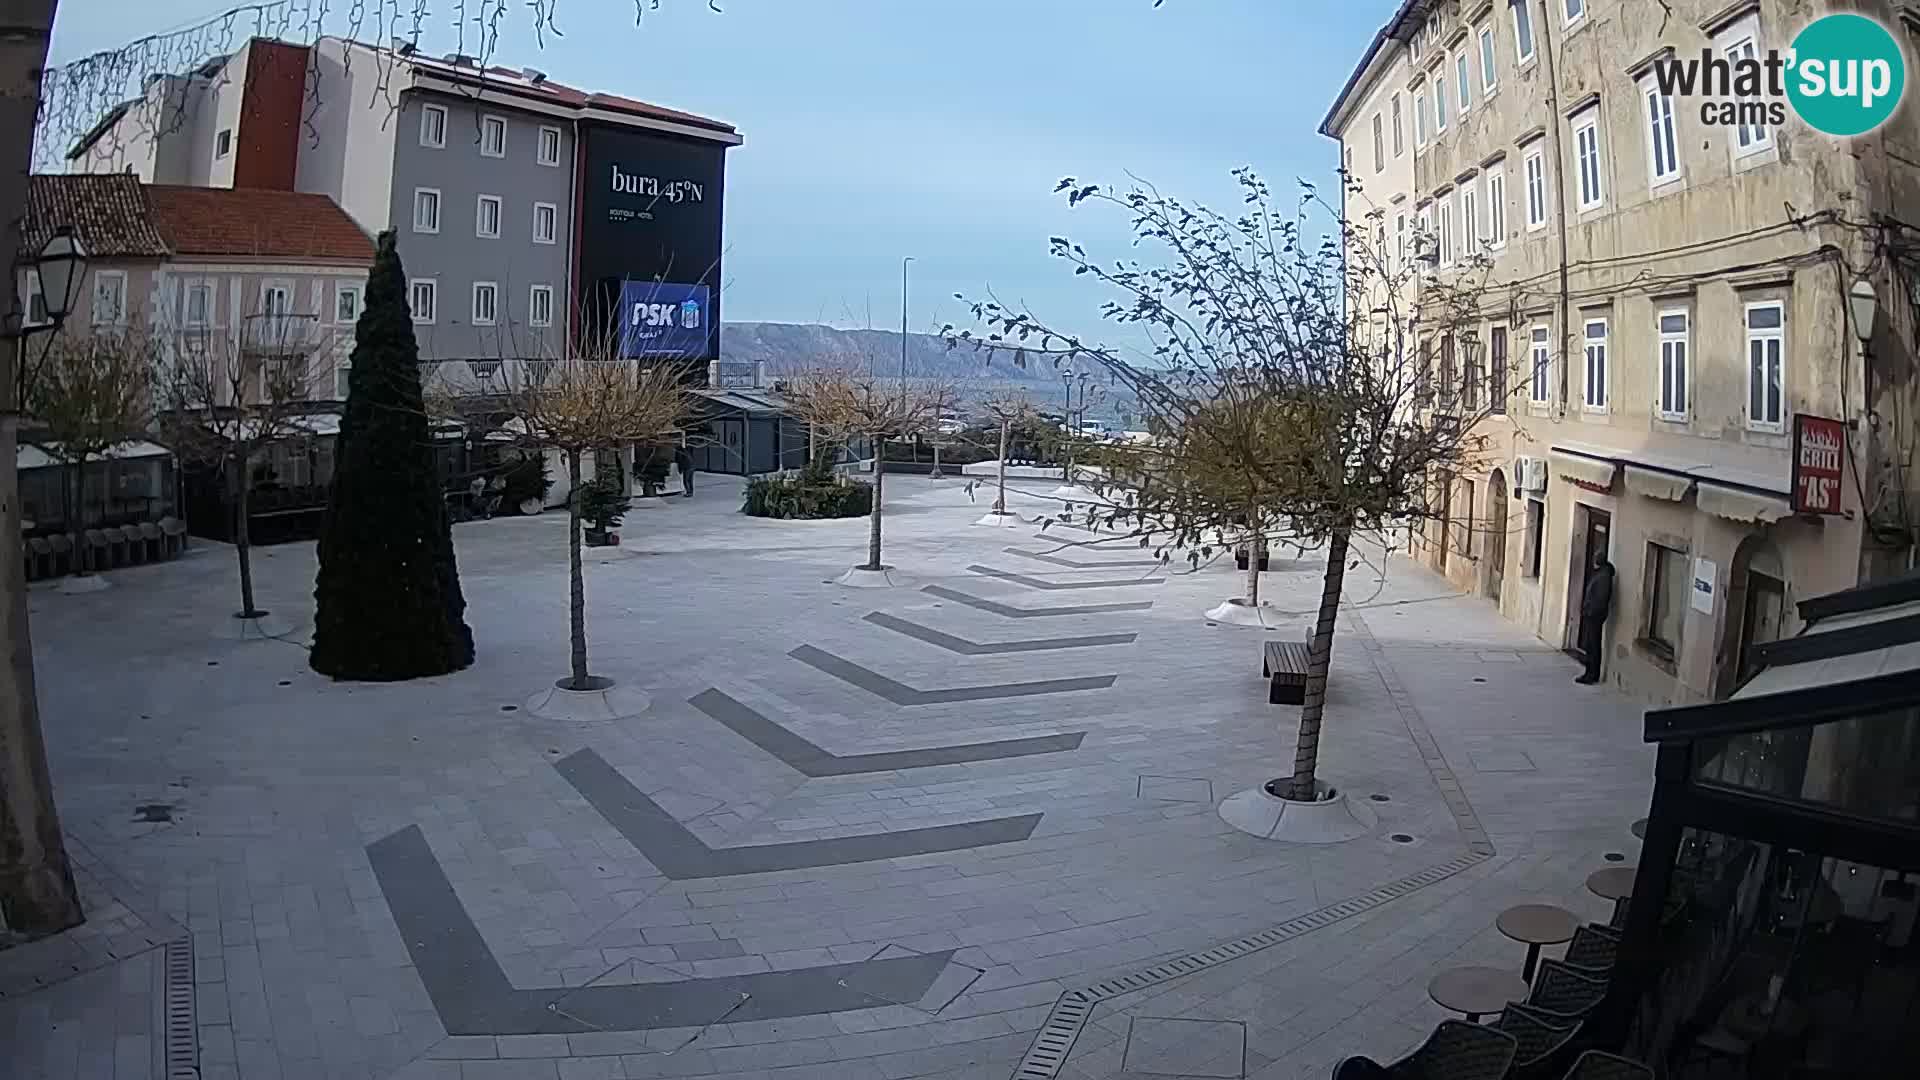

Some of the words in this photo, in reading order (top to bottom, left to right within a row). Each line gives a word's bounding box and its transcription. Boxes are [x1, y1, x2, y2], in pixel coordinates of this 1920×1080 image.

[612, 165, 658, 196] bura
[631, 302, 677, 327] PSK
[1800, 447, 1840, 471] GRILL
